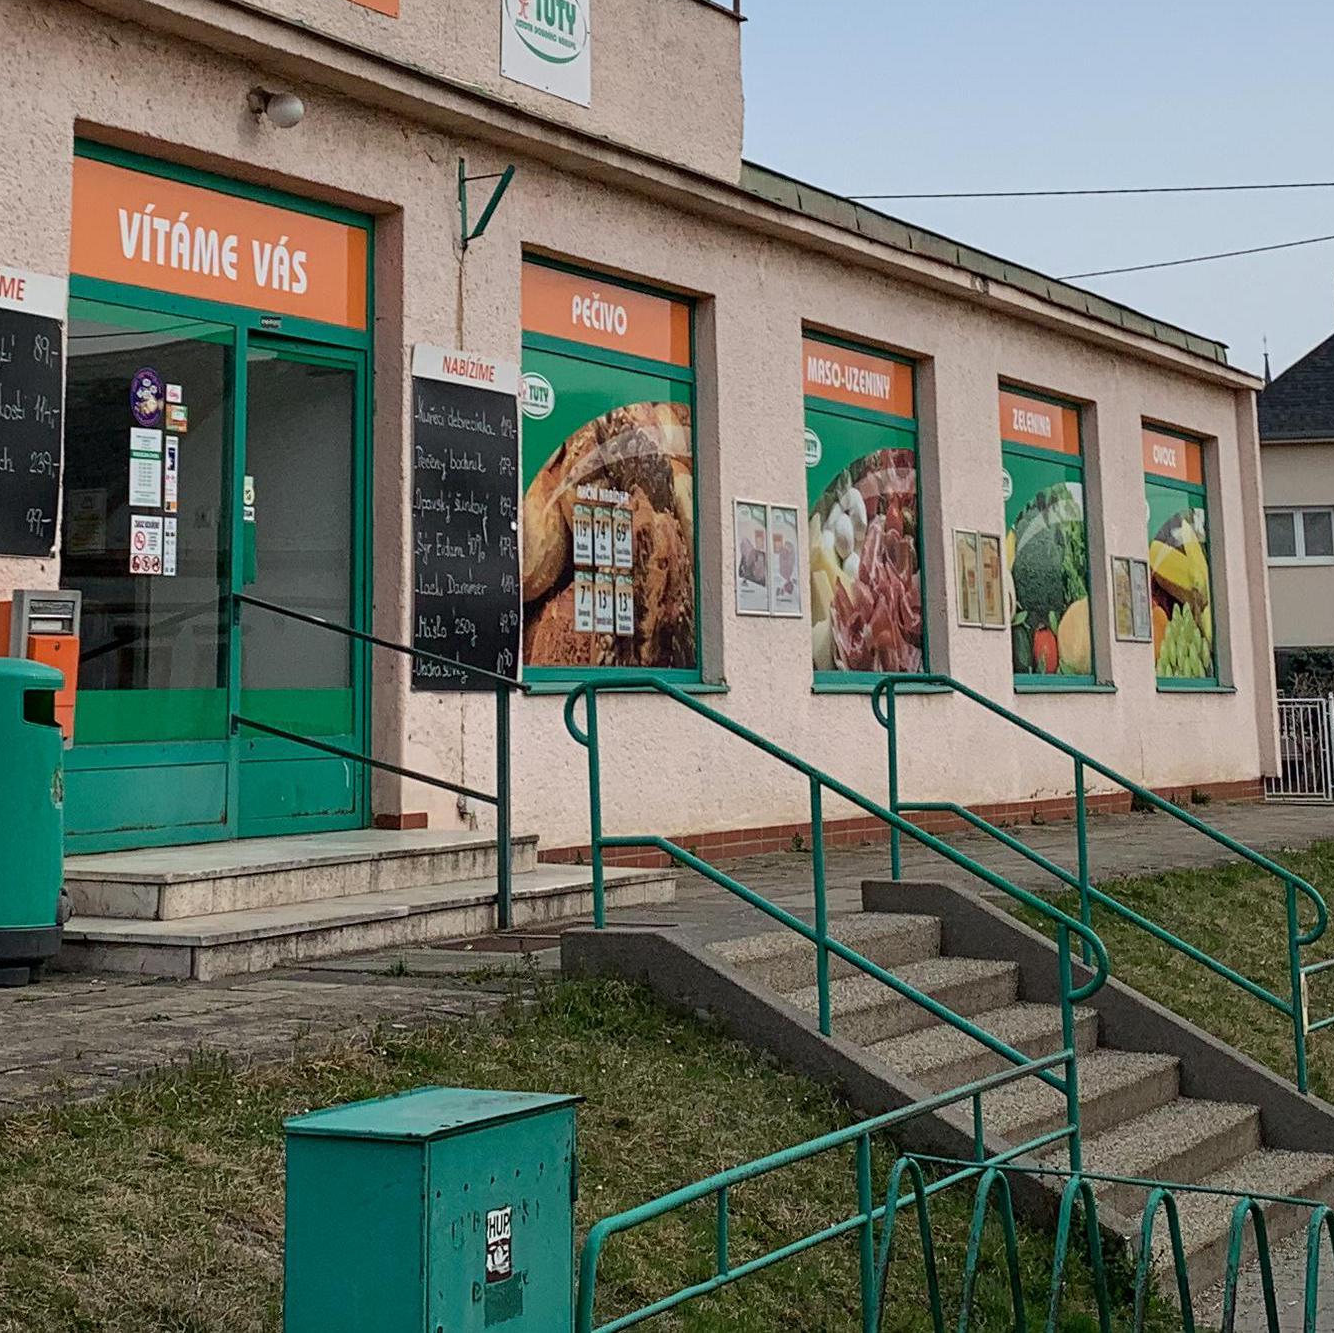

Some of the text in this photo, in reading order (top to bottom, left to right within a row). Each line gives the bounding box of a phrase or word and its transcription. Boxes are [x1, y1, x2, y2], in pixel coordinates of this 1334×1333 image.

[119, 203, 308, 295] VÍTÁME VÁS
[571, 292, 628, 336] PEČIVO
[443, 355, 496, 383] NABÍZÍME
[807, 355, 891, 400] MASO-UZENINY
[529, 385, 548, 403] TUTY
